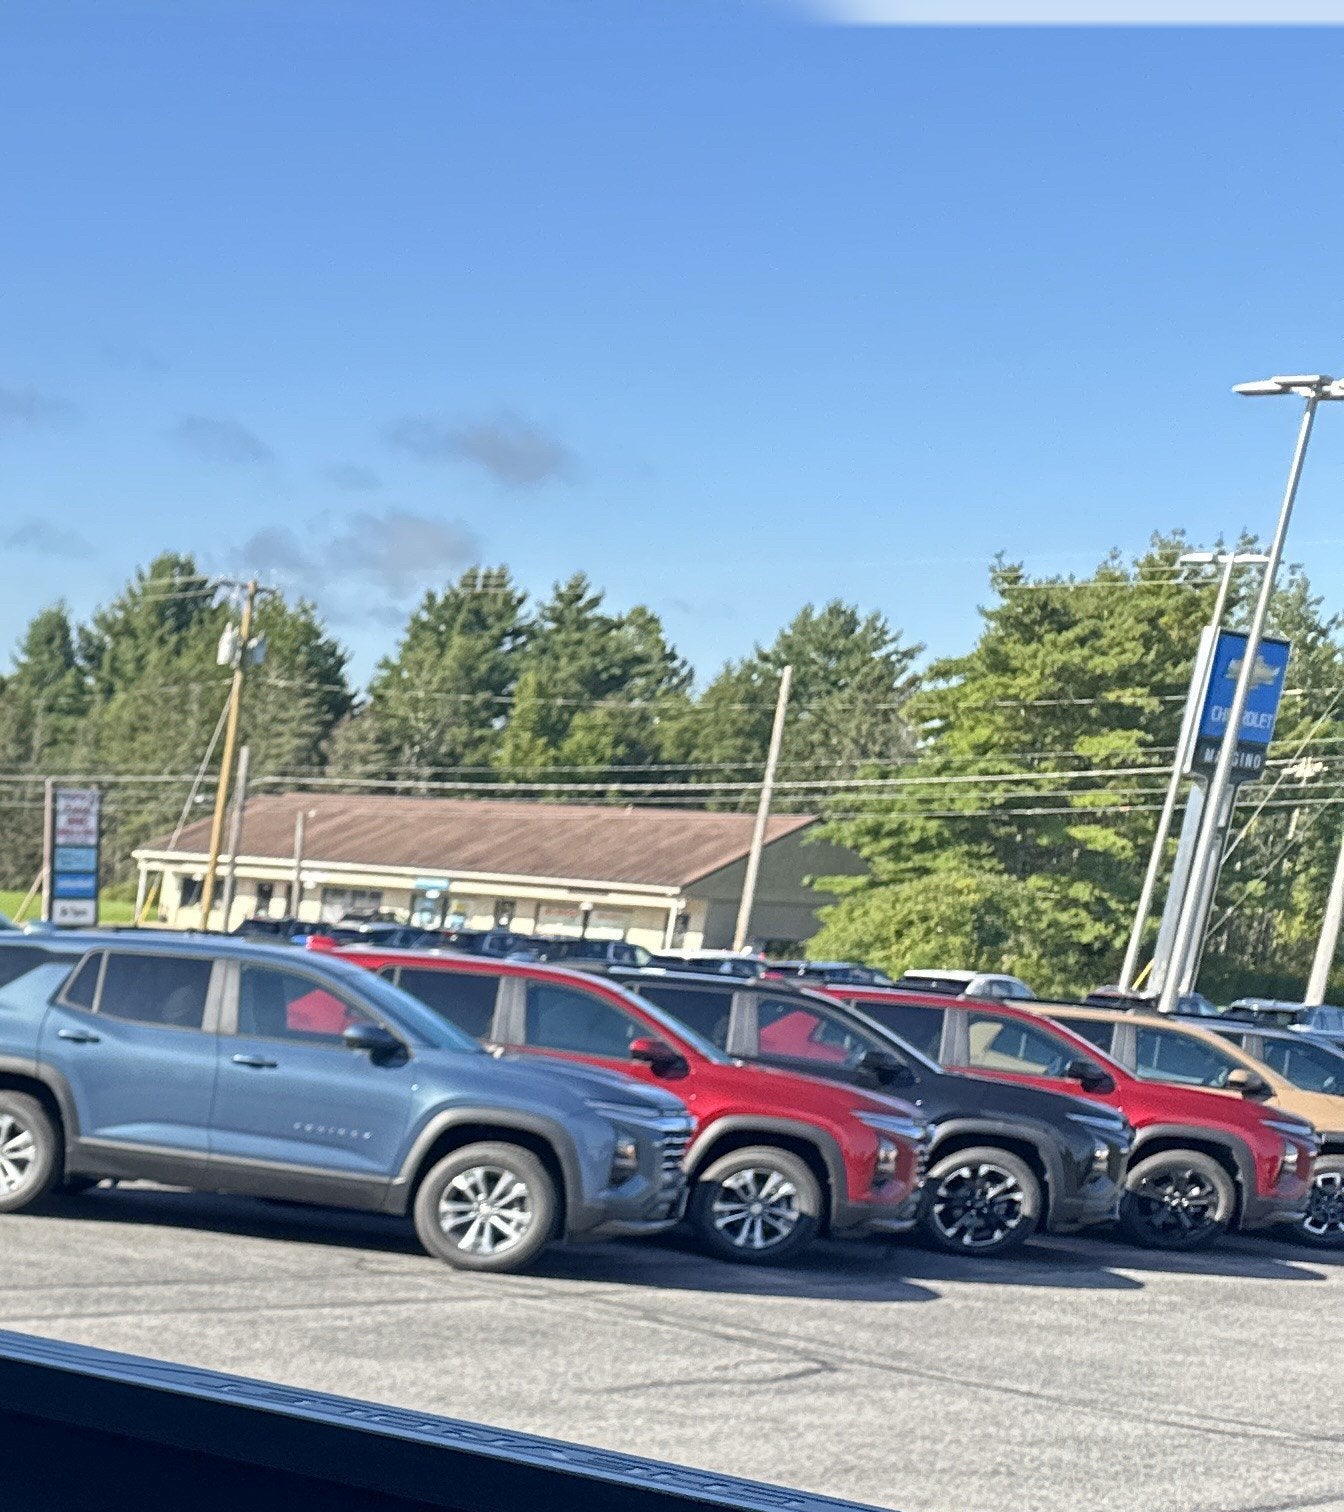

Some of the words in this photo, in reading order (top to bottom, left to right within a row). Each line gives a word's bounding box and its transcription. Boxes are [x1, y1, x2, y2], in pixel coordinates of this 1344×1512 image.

[1211, 705, 1274, 729] CHOLET
[1204, 747, 1261, 769] MGINO
[194, 1380, 806, 1508] CHEVROLET
